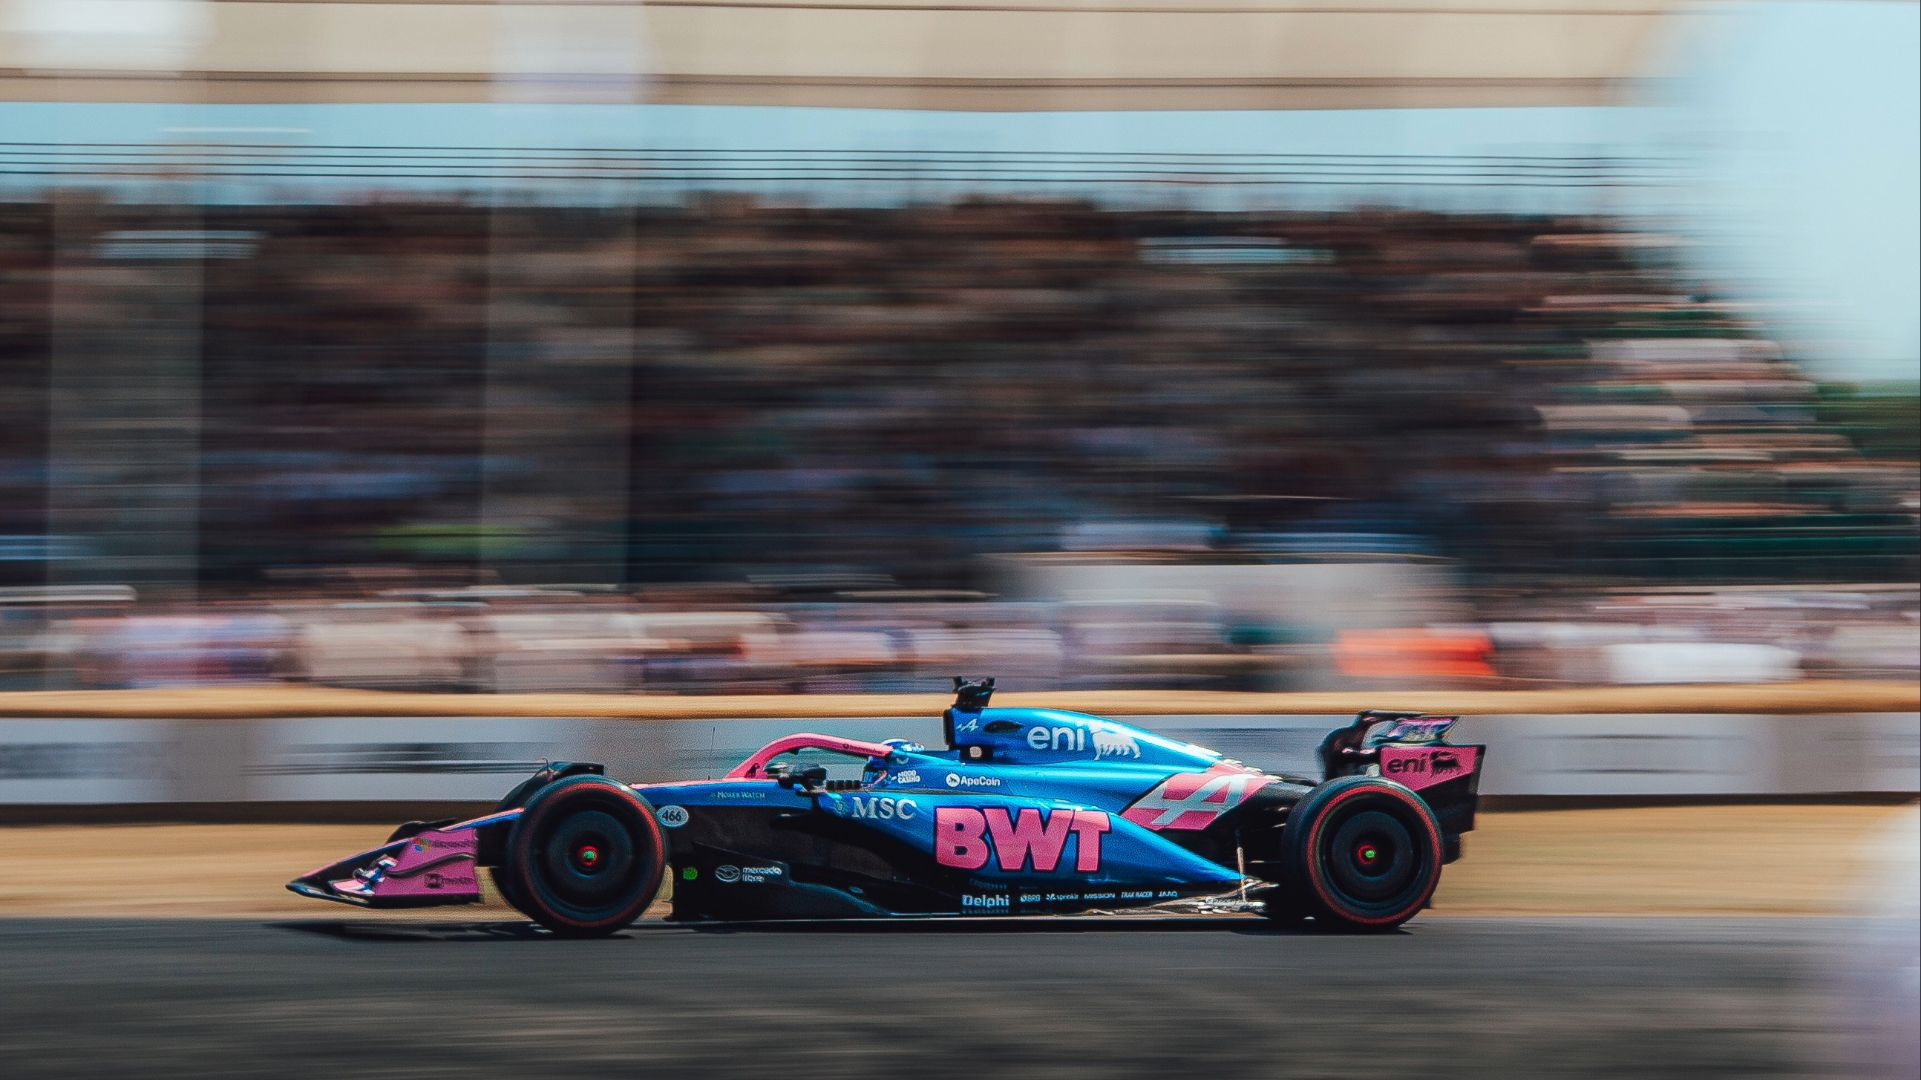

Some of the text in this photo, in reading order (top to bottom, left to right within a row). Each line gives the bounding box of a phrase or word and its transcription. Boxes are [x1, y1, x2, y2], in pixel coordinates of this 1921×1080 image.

[1027, 721, 1085, 750] eni
[1387, 752, 1429, 773] eni
[960, 776, 1001, 787] ApeCoin
[661, 809, 682, 821] 466
[852, 796, 917, 820] MSC
[935, 807, 1111, 872] BWT
[742, 865, 782, 875] mercado
[962, 894, 1010, 908] Delphi
